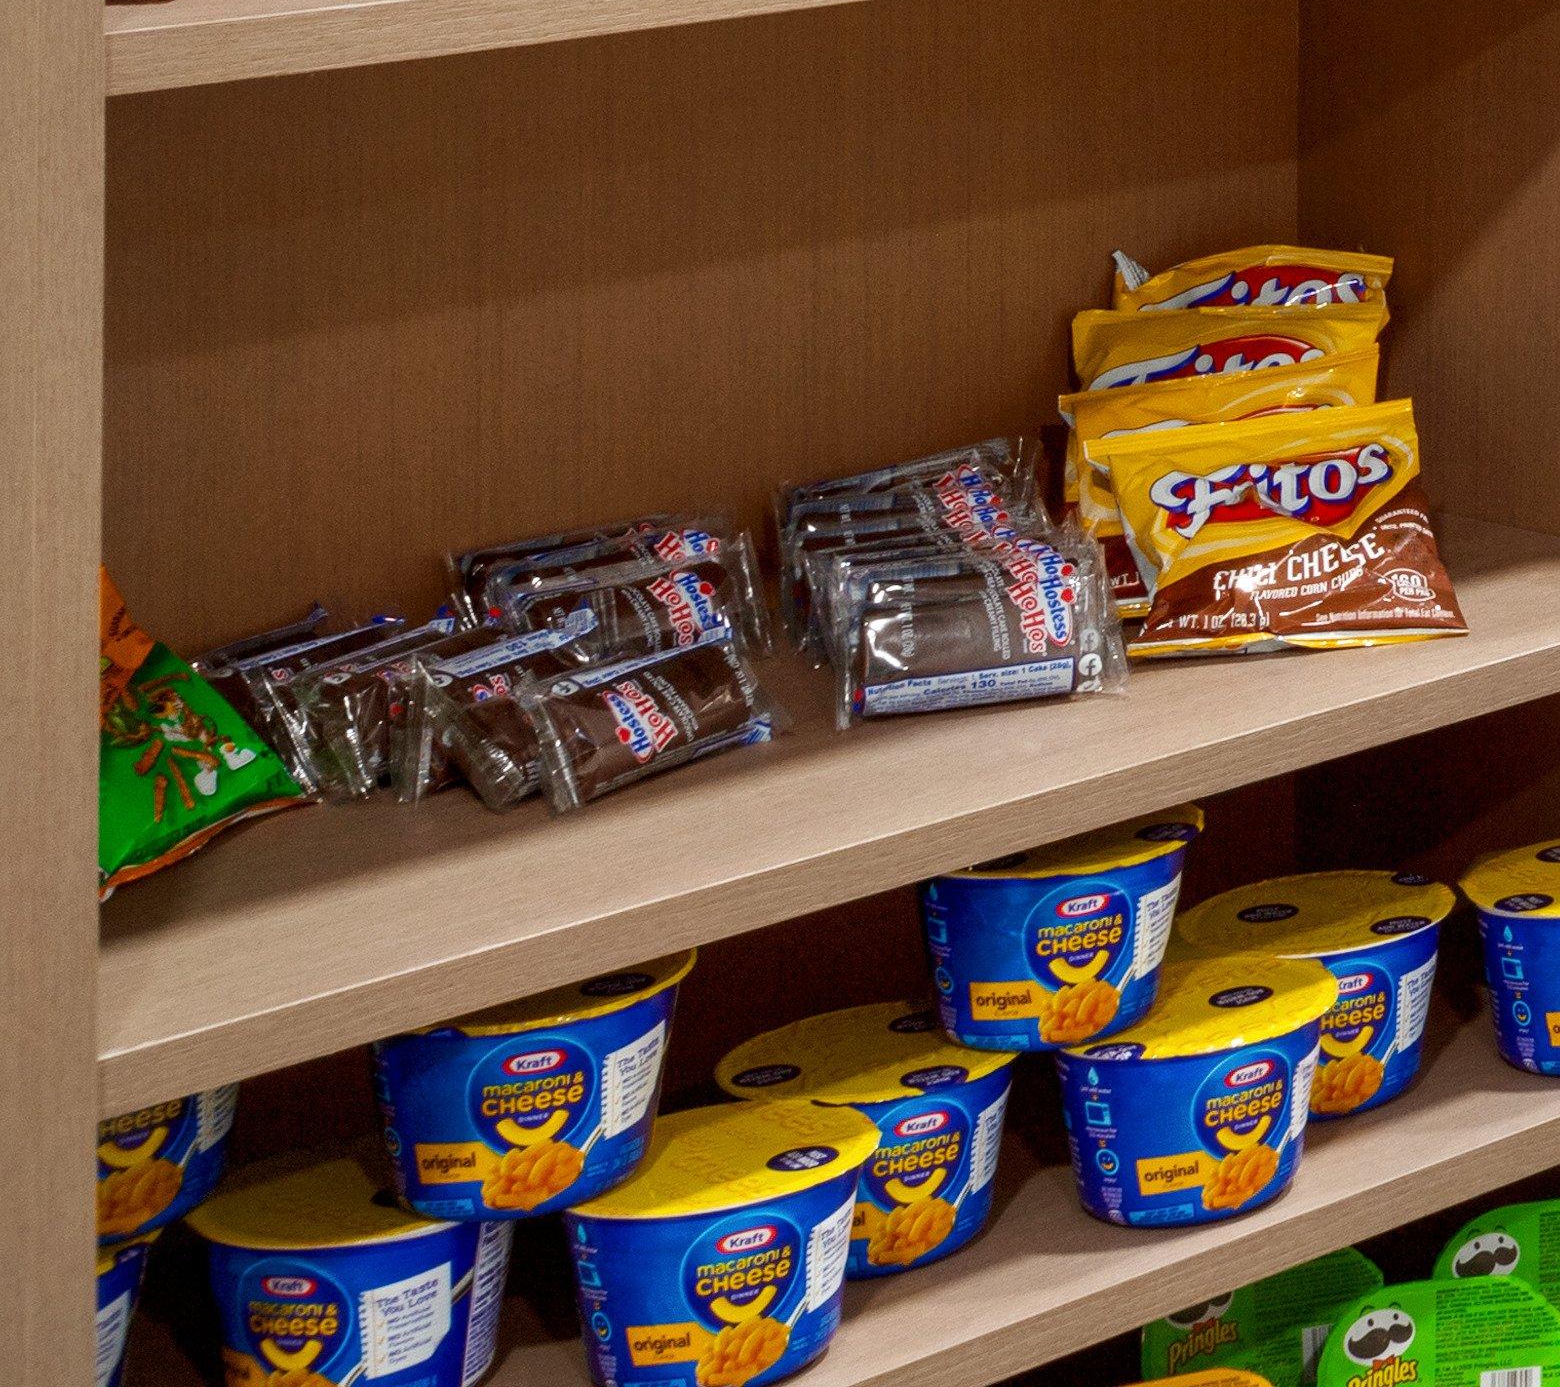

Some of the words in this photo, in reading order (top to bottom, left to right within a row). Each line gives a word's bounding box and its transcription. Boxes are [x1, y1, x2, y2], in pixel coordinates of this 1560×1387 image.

[1150, 443, 1392, 540] Fritos
[1287, 533, 1386, 582] CHEESE
[1249, 586, 1298, 602] FLAVORED
[1300, 580, 1328, 596] CORN
[971, 679, 997, 689] 130
[1064, 897, 1101, 915] Kraft
[1037, 920, 1112, 940] macaroni
[976, 990, 1032, 1010] original
[515, 1055, 553, 1073] Kraft
[1232, 1065, 1266, 1084] Kraft
[482, 1075, 570, 1097] macaroni
[1206, 1084, 1278, 1107] macaroni
[901, 1115, 938, 1134] Kraft
[874, 1136, 950, 1160] macaroni
[421, 1153, 476, 1173] original
[1143, 1162, 1199, 1184] original
[724, 1231, 763, 1252] Kraft
[697, 1254, 777, 1277] macaroni
[402, 1278, 439, 1301] Taste
[633, 1332, 691, 1354] original
[1170, 1320, 1237, 1374] Pringles
